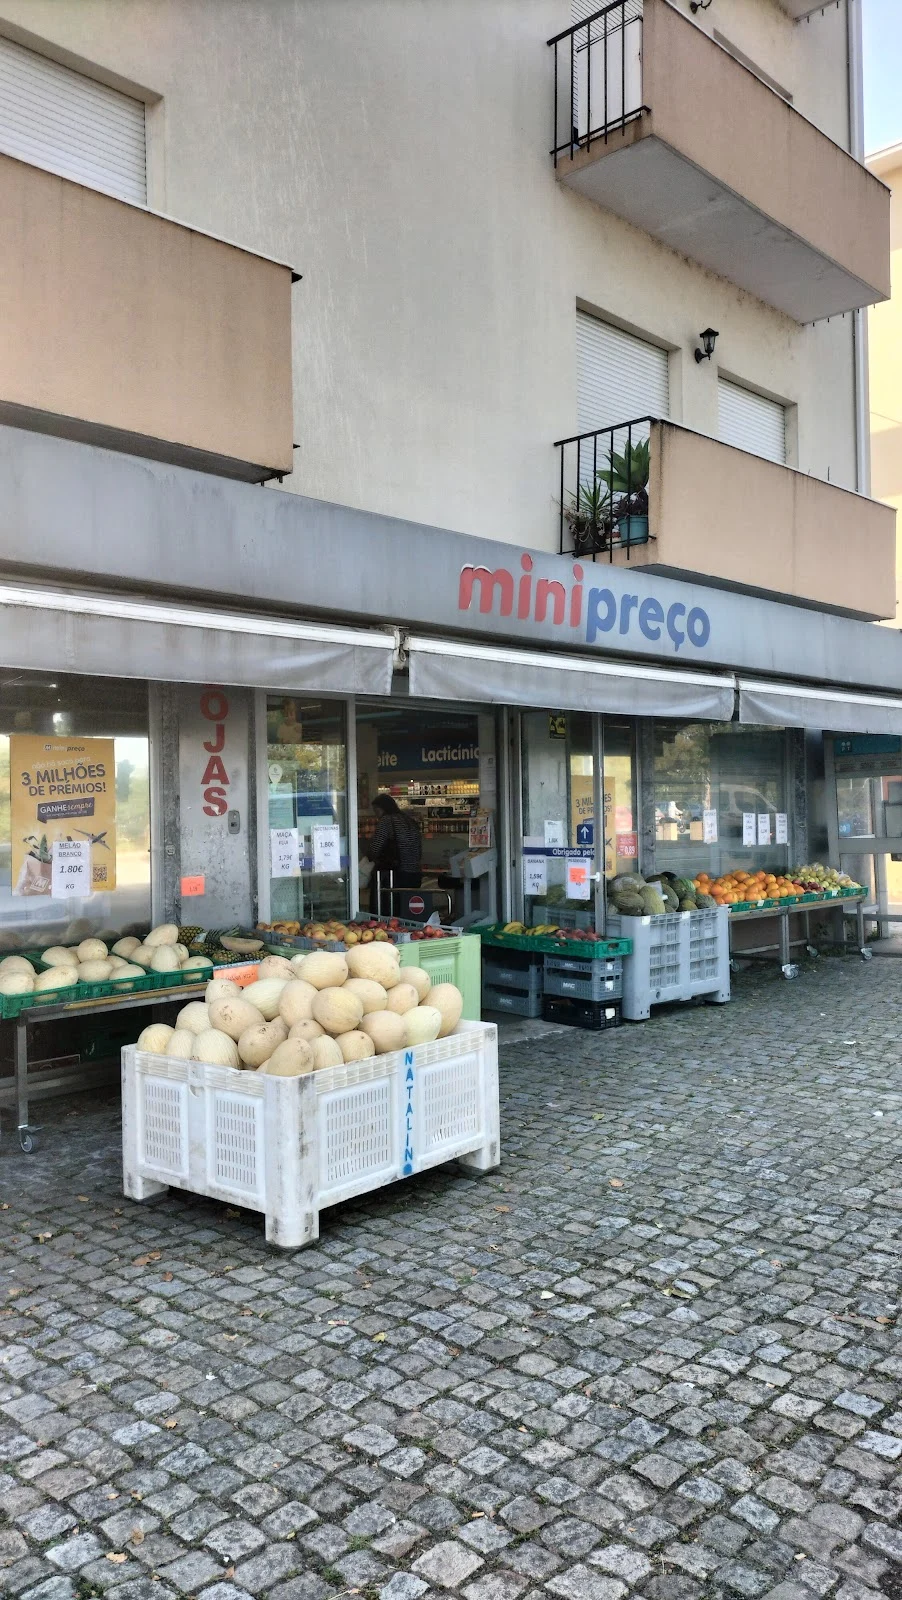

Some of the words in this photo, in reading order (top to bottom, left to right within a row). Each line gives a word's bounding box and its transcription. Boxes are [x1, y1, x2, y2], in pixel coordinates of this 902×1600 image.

[458, 552, 711, 652] minipreço
[200, 684, 230, 817] OJAS
[21, 771, 32, 786] 3
[36, 763, 106, 785] MILHÕES
[29, 785, 45, 796] DE
[49, 779, 107, 796] PRÉMIOS!
[575, 798, 580, 808] 3
[581, 793, 612, 807] MILES
[40, 804, 67, 814] GANHE
[552, 848, 581, 857] Obrigado
[59, 865, 84, 874] 1.80€
